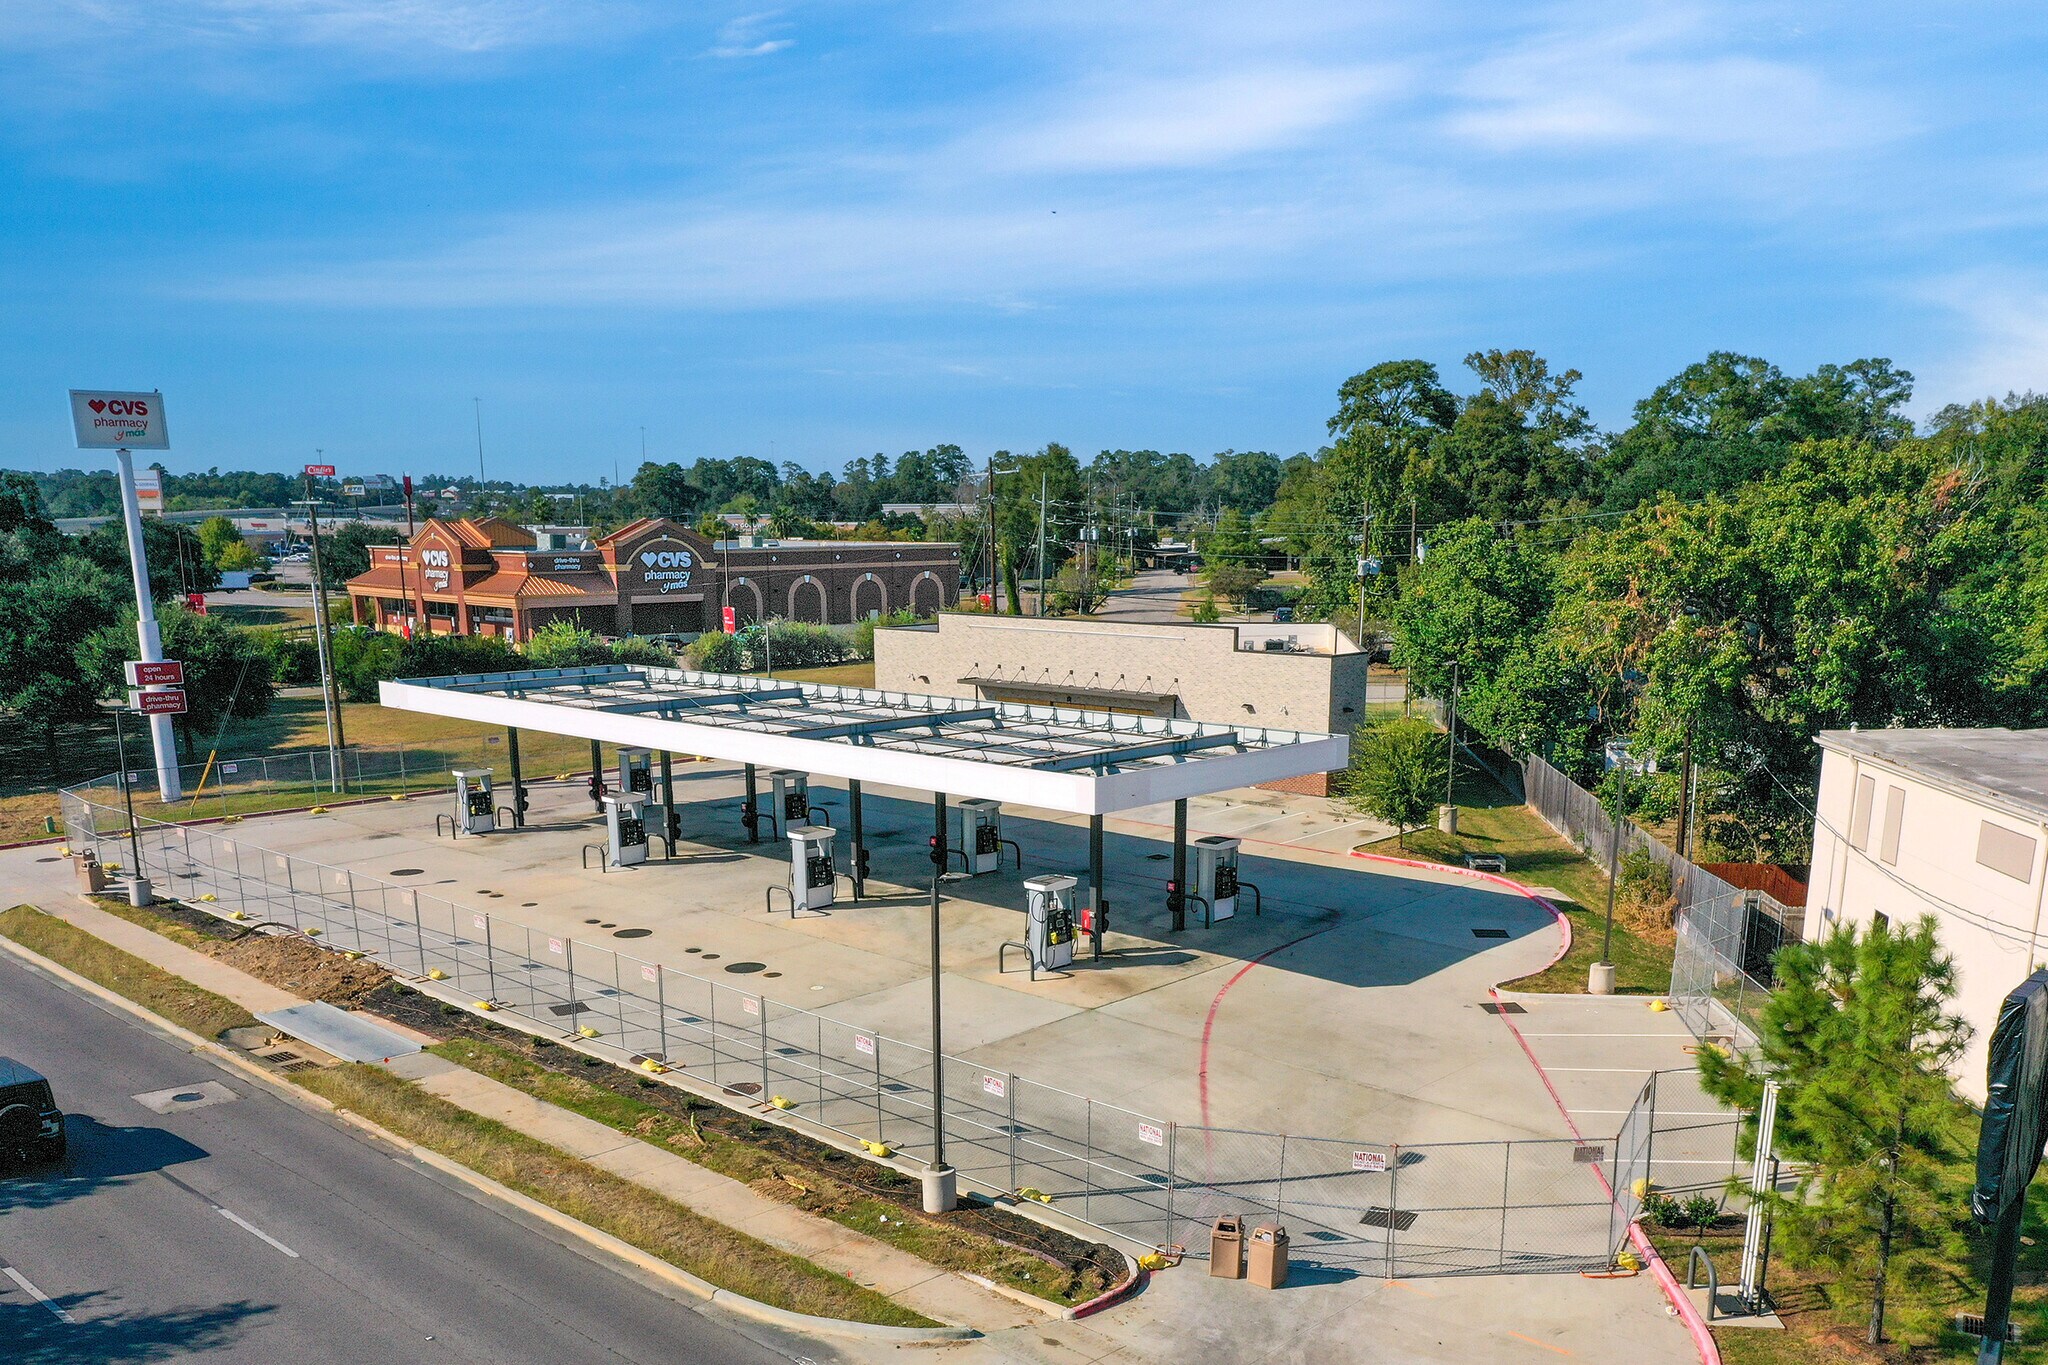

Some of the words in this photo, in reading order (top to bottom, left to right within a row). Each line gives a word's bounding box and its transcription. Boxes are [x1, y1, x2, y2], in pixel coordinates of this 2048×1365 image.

[108, 399, 149, 416] CVS
[94, 416, 148, 430] pharmacy
[114, 430, 125, 441] y
[125, 428, 146, 437] más
[430, 550, 449, 567] CVS
[657, 551, 692, 568] CVS
[554, 563, 581, 571] pharmacy
[424, 568, 449, 581] pharmacy
[644, 569, 691, 582] pharmacy
[660, 582, 671, 594] y
[670, 578, 688, 590] más
[143, 666, 162, 674] open
[145, 695, 180, 703] drive-thru
[146, 702, 181, 711] pharmacy
[1139, 1124, 1162, 1138] NATIONAL
[1354, 1151, 1385, 1163] NATIONAL
